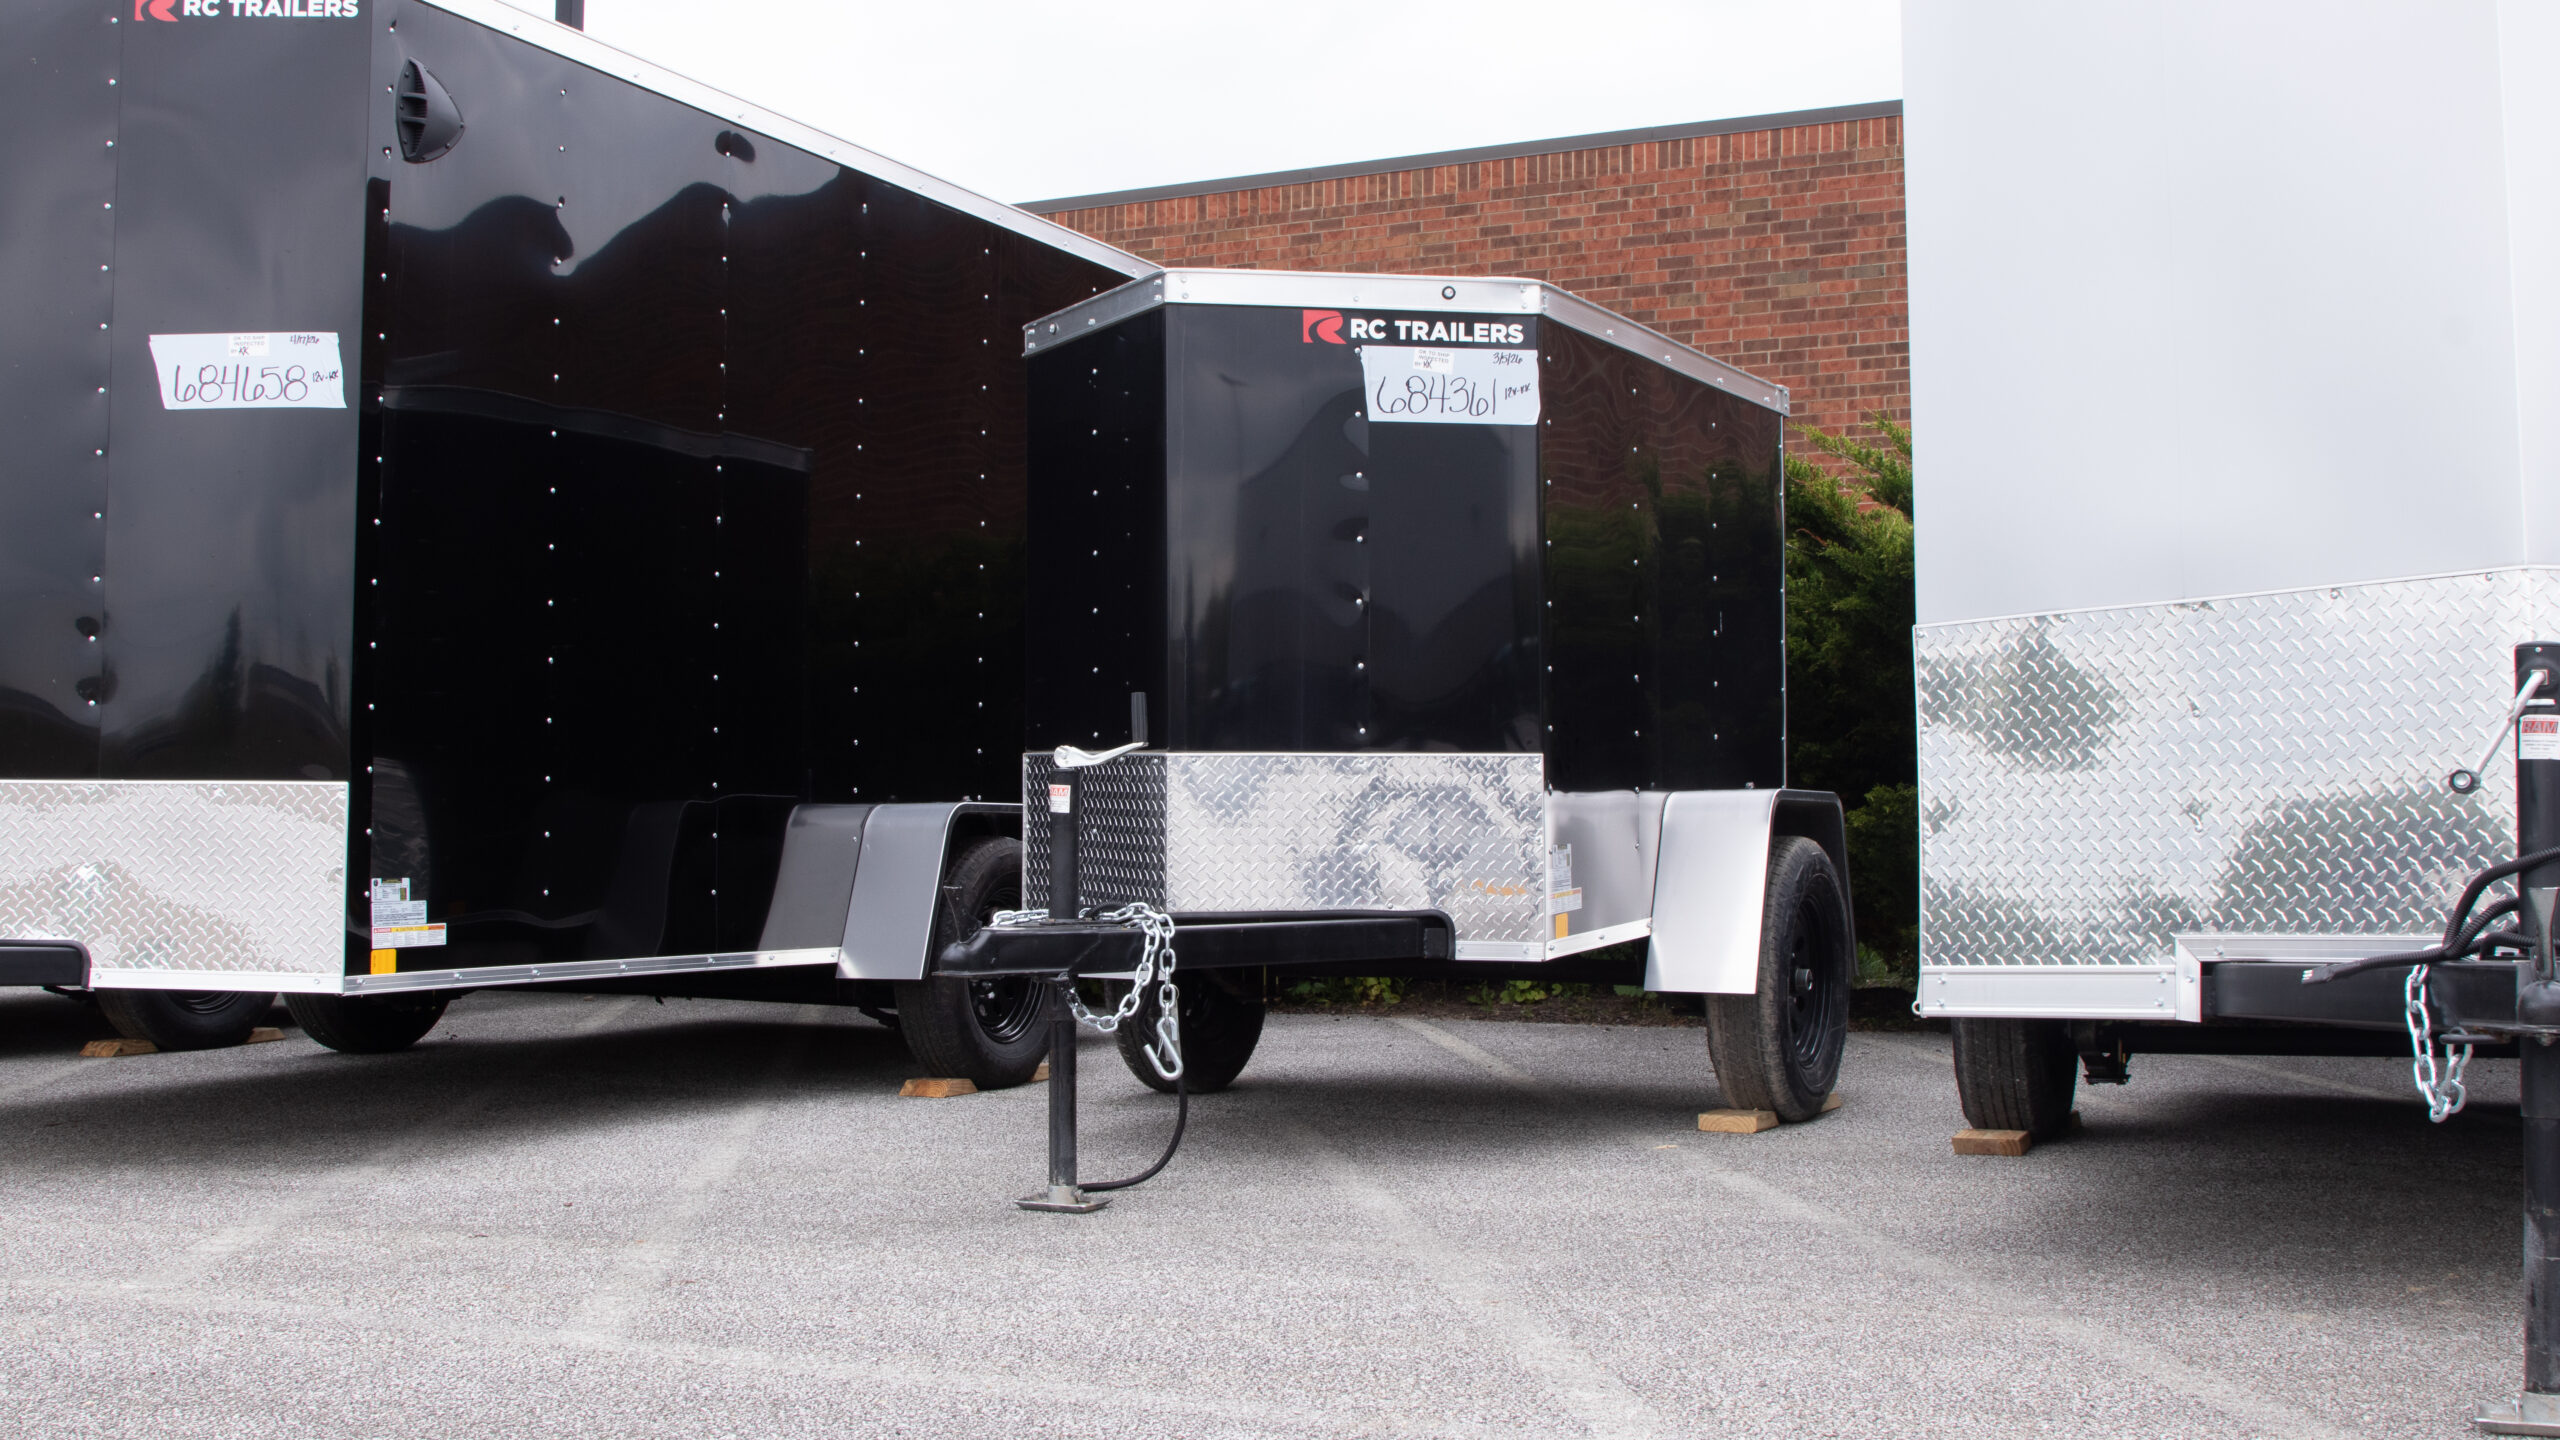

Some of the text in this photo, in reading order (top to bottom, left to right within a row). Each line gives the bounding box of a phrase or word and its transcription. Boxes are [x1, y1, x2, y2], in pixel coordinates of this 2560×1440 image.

[182, 0, 220, 16] RC
[227, 0, 359, 17] TRAILERS
[1350, 318, 1387, 340] RC
[1394, 319, 1525, 344] TRAILERS
[1492, 351, 1523, 366] 3/5/26
[174, 364, 308, 402] 684658
[1376, 374, 1498, 417] 684361
[2523, 720, 2559, 733] RAM
